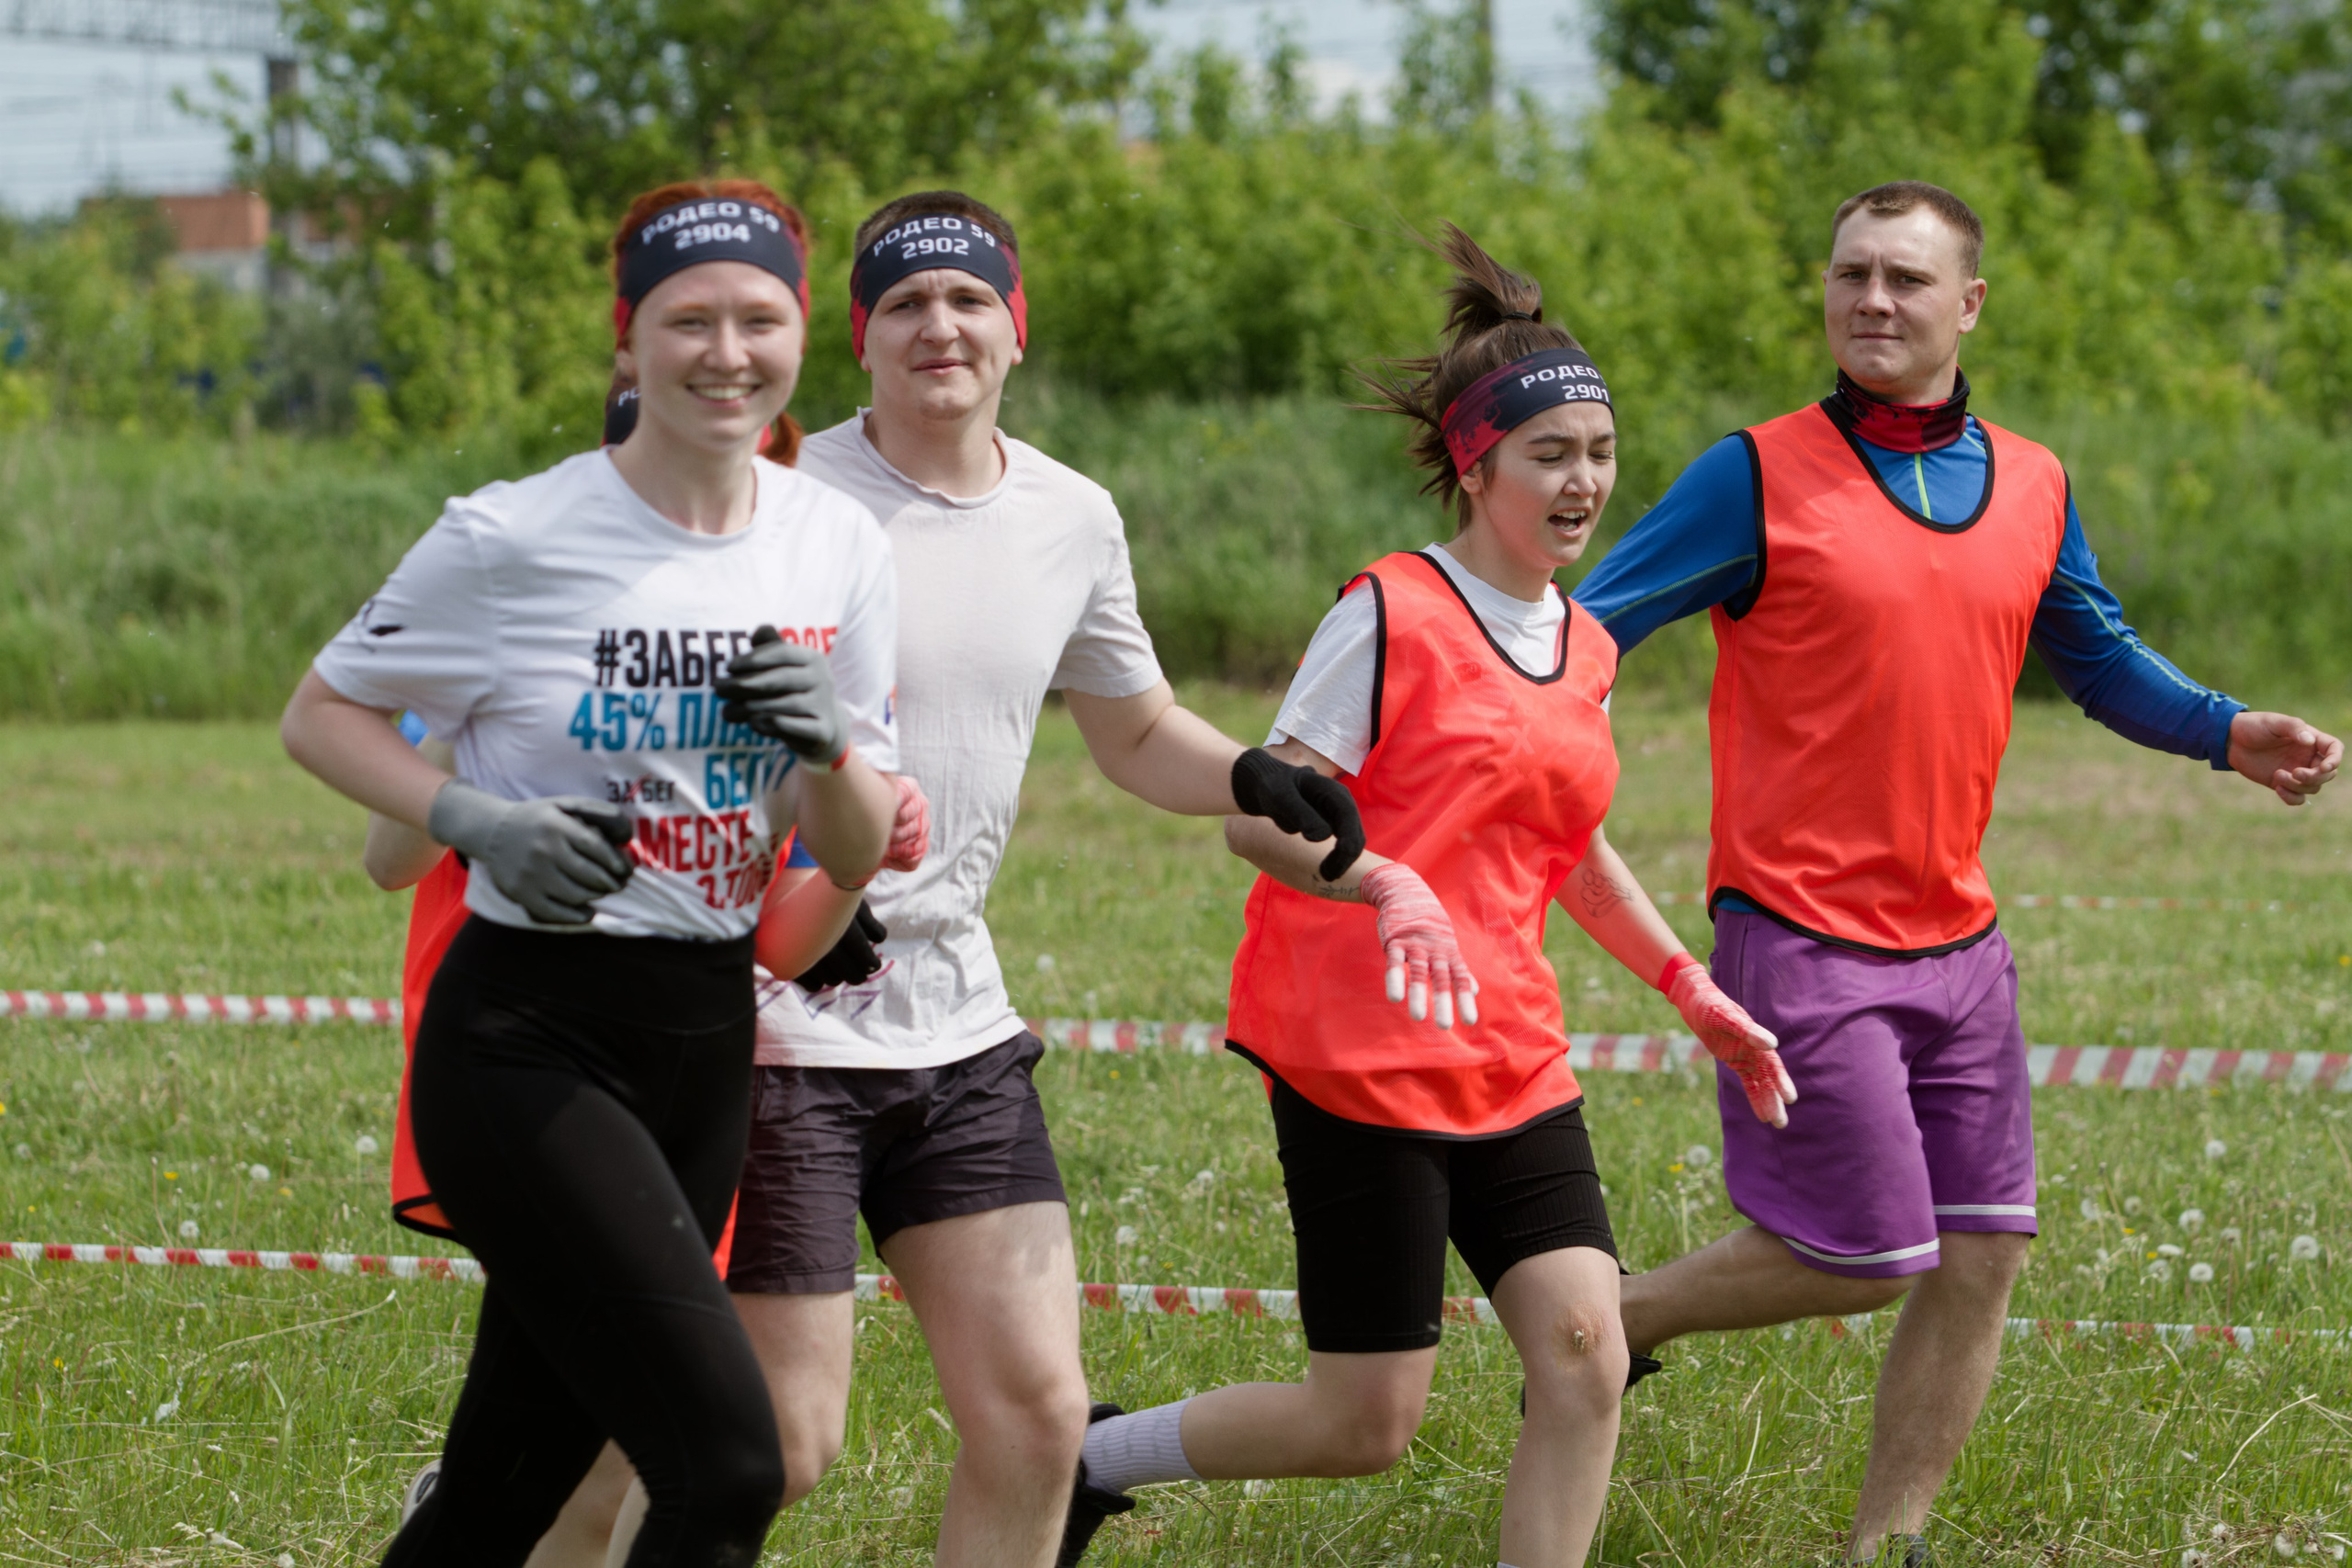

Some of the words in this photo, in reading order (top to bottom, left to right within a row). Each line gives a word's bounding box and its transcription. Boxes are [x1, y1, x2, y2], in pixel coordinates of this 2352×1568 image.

[641, 202, 741, 244] РОДЕО
[748, 206, 780, 233] 59
[674, 222, 752, 250] 2904
[874, 217, 963, 257] РОДЕО
[970, 223, 996, 248] 59
[901, 237, 969, 260] 2902
[1521, 365, 1600, 389] РОДЕО
[1562, 384, 1610, 403] 2901
[568, 692, 665, 750] 45%
[628, 809, 753, 873] МЕСТЕ
